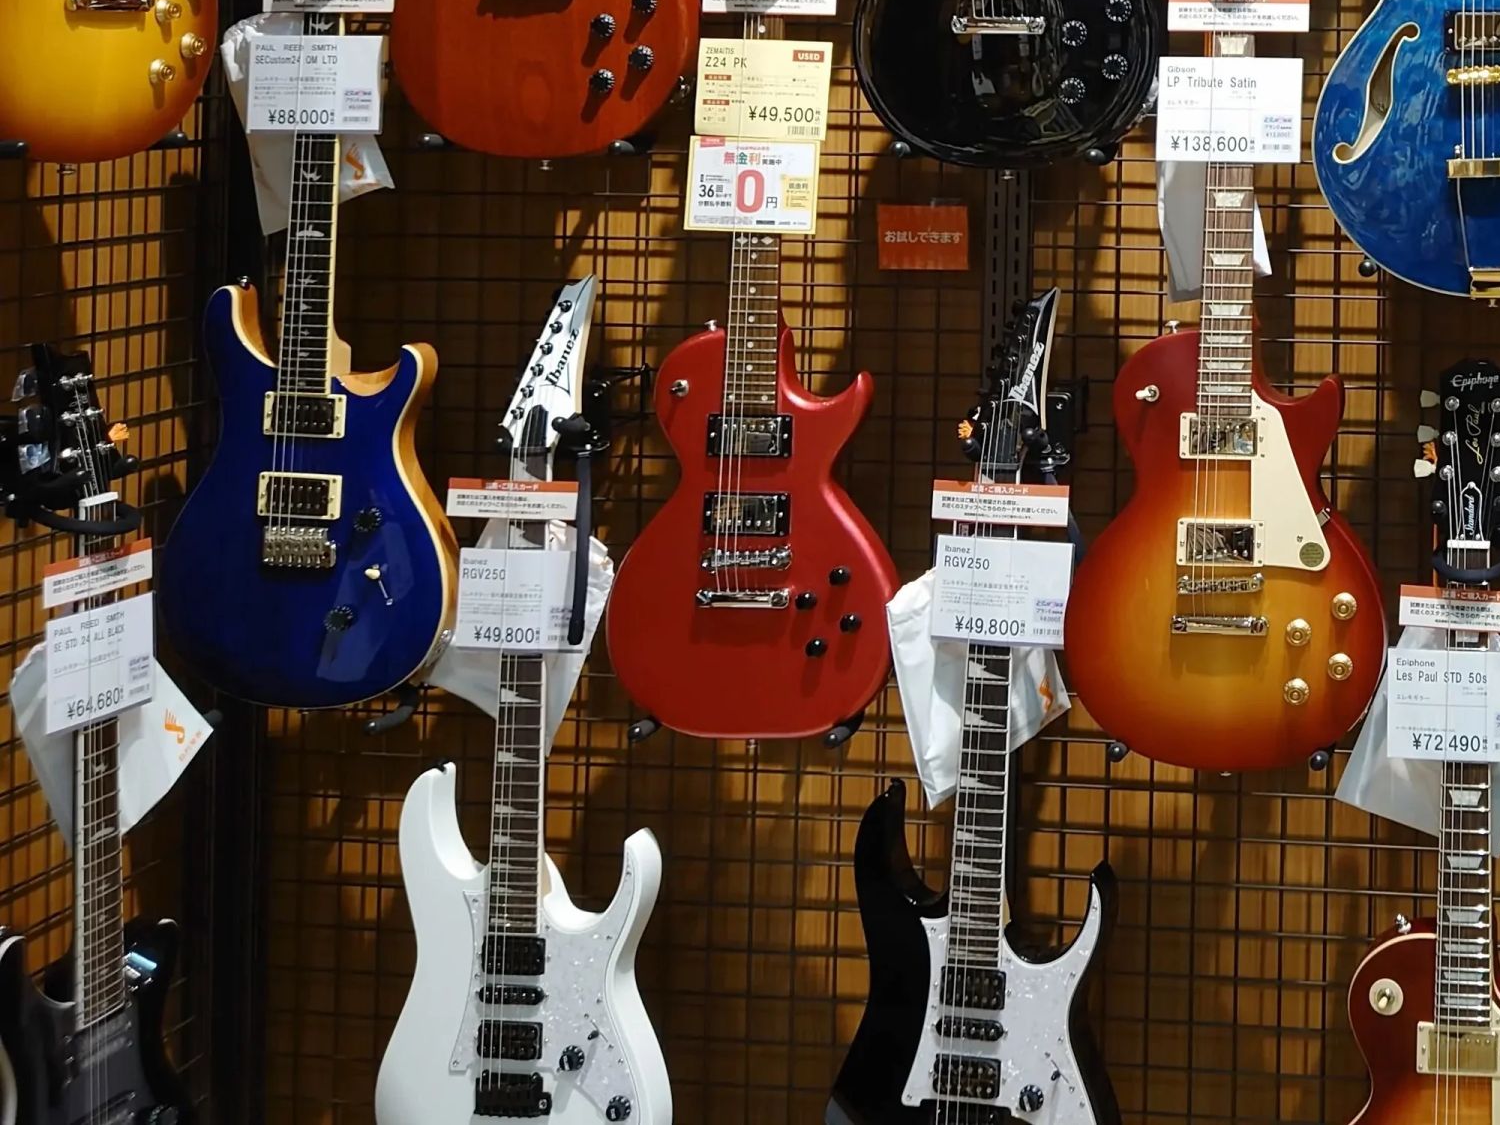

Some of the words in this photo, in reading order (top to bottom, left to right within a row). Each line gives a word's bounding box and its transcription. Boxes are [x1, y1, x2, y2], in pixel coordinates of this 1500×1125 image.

[255, 44, 277, 53] PAUL
[283, 43, 304, 52] REED
[311, 43, 338, 52] SMITH
[705, 46, 735, 55] ZEMAITIS
[321, 55, 339, 65] LTD
[704, 56, 727, 68] Z24
[733, 56, 748, 69] PK
[797, 52, 820, 62] USED
[1167, 65, 1196, 74] Gibson
[1167, 76, 1180, 89] LP
[1187, 76, 1224, 89] Tribute
[1229, 76, 1257, 89] Satin
[267, 109, 330, 126] ¥88,000
[748, 105, 814, 123] ¥49,500
[1170, 135, 1249, 153] ¥138,600
[724, 151, 761, 165] 無金利
[698, 184, 715, 198] 36
[736, 169, 765, 214] 0
[765, 196, 778, 209] 円
[883, 229, 963, 245] お試しできます
[543, 328, 580, 388] Ibanez
[1007, 341, 1046, 406] Ibanez
[1450, 371, 1500, 393] Epiphone
[1464, 493, 1475, 536] Standard
[944, 544, 971, 554] Ibanez
[462, 557, 488, 566] Ibanez
[943, 555, 990, 571] RGV250
[461, 567, 507, 581] RGV250
[53, 624, 73, 639] PAUL
[80, 618, 100, 632] REED
[105, 610, 125, 624] SMITH
[954, 615, 1020, 637] ¥49,800
[53, 641, 62, 653] SE
[64, 637, 78, 651] STD
[93, 629, 105, 642] ALL
[107, 623, 125, 639] BLACK
[473, 626, 535, 644] ¥49,800
[1395, 657, 1436, 669] Epiphone
[1395, 669, 1413, 683] Les
[1417, 669, 1439, 684] Paul
[1443, 671, 1462, 684] STD
[1468, 672, 1488, 685] 50s
[66, 687, 121, 722] ¥64,680
[1412, 732, 1481, 753] ¥72490
